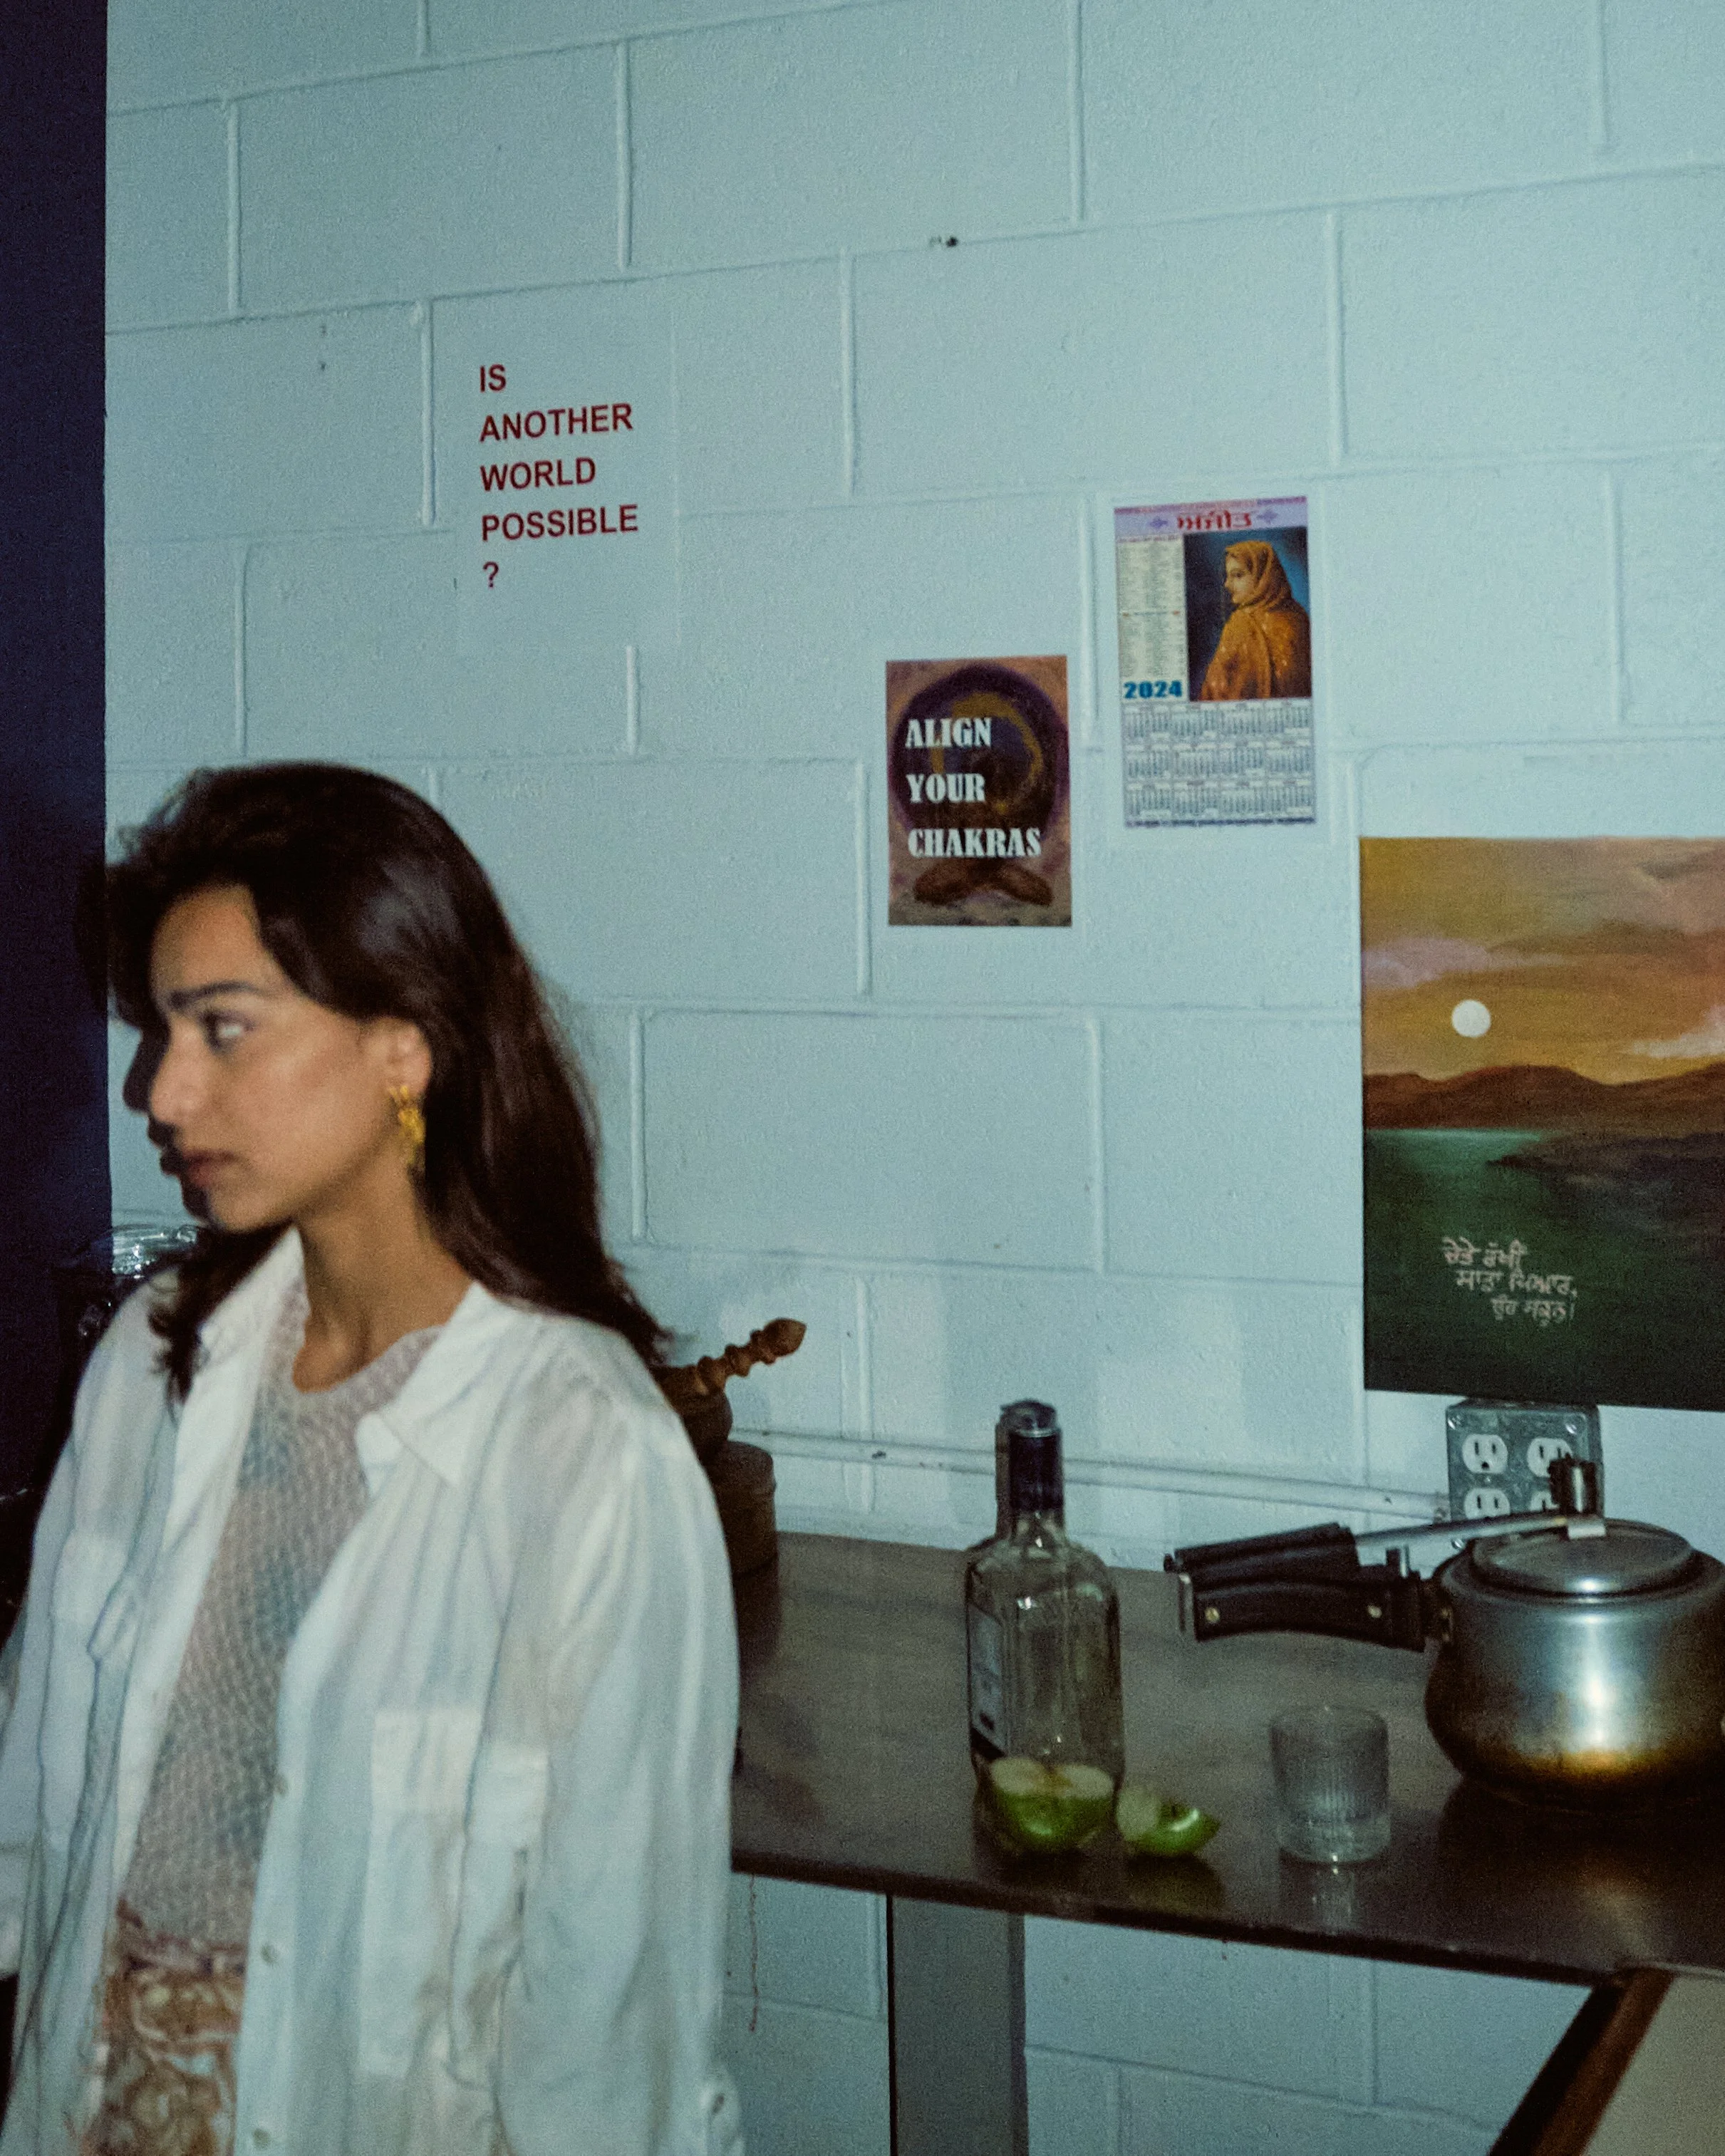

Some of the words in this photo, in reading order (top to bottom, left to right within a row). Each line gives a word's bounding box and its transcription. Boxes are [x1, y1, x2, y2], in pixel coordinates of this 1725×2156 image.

[480, 363, 507, 393] IS
[480, 403, 633, 442] ANOTHER
[480, 457, 596, 492] WORLD
[481, 503, 639, 541] POSSIBLE
[482, 561, 499, 589] ?
[1123, 680, 1183, 700] 2024
[905, 717, 992, 748] ALIGN
[906, 773, 986, 804] YOUR
[907, 828, 1042, 859] CHAKRAS
